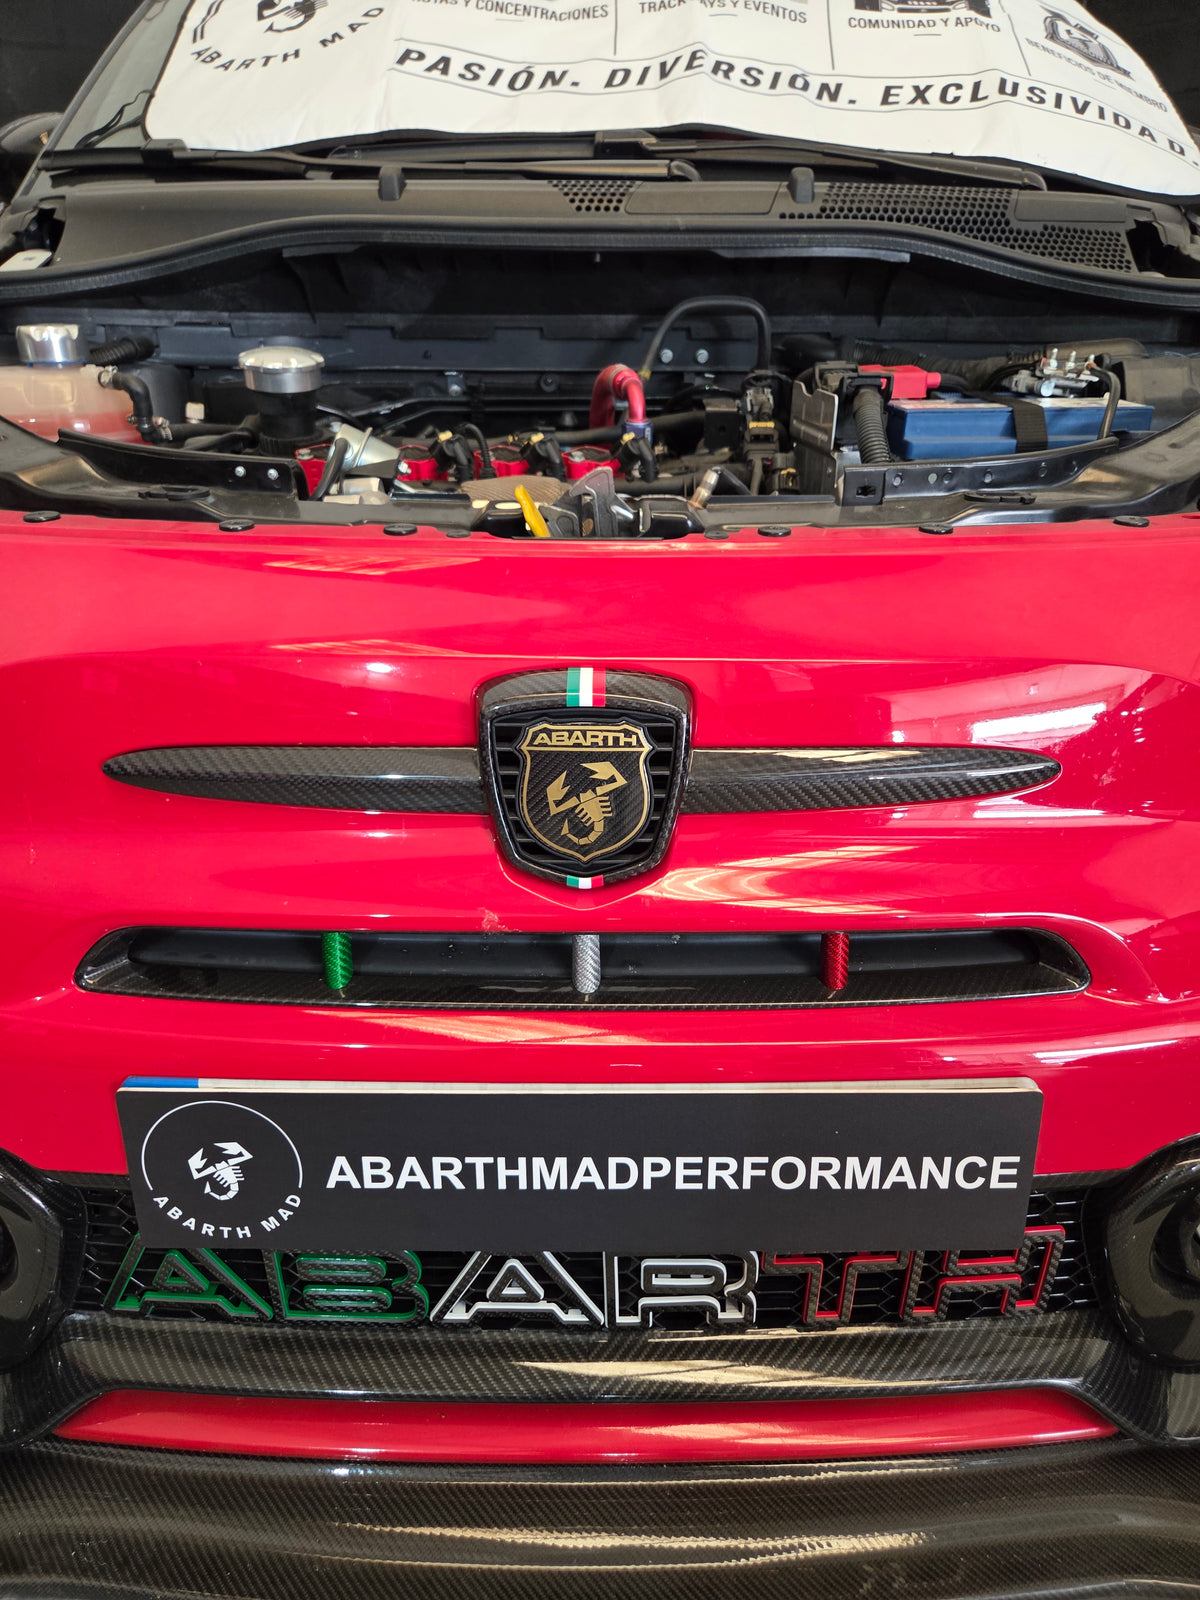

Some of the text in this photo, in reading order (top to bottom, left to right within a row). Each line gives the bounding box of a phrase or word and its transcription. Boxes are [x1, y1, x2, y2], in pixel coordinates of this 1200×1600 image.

[475, 0, 609, 22] CONCENTRACIONES
[744, 0, 807, 24] EVENTOS
[848, 17, 1001, 32] COMUNIDAD Y APOYO
[190, 7, 384, 71] ABARTH MAD
[396, 48, 1199, 167] PASIÓN. DIVERSIÓN. EXCLUSIVIDAD.
[533, 730, 637, 746] ABARTH
[325, 1155, 1021, 1191] ABARTHMADPERFORMANCE
[152, 1193, 302, 1239] ABARTH MAD
[100, 1224, 1067, 1328] ABARTH
